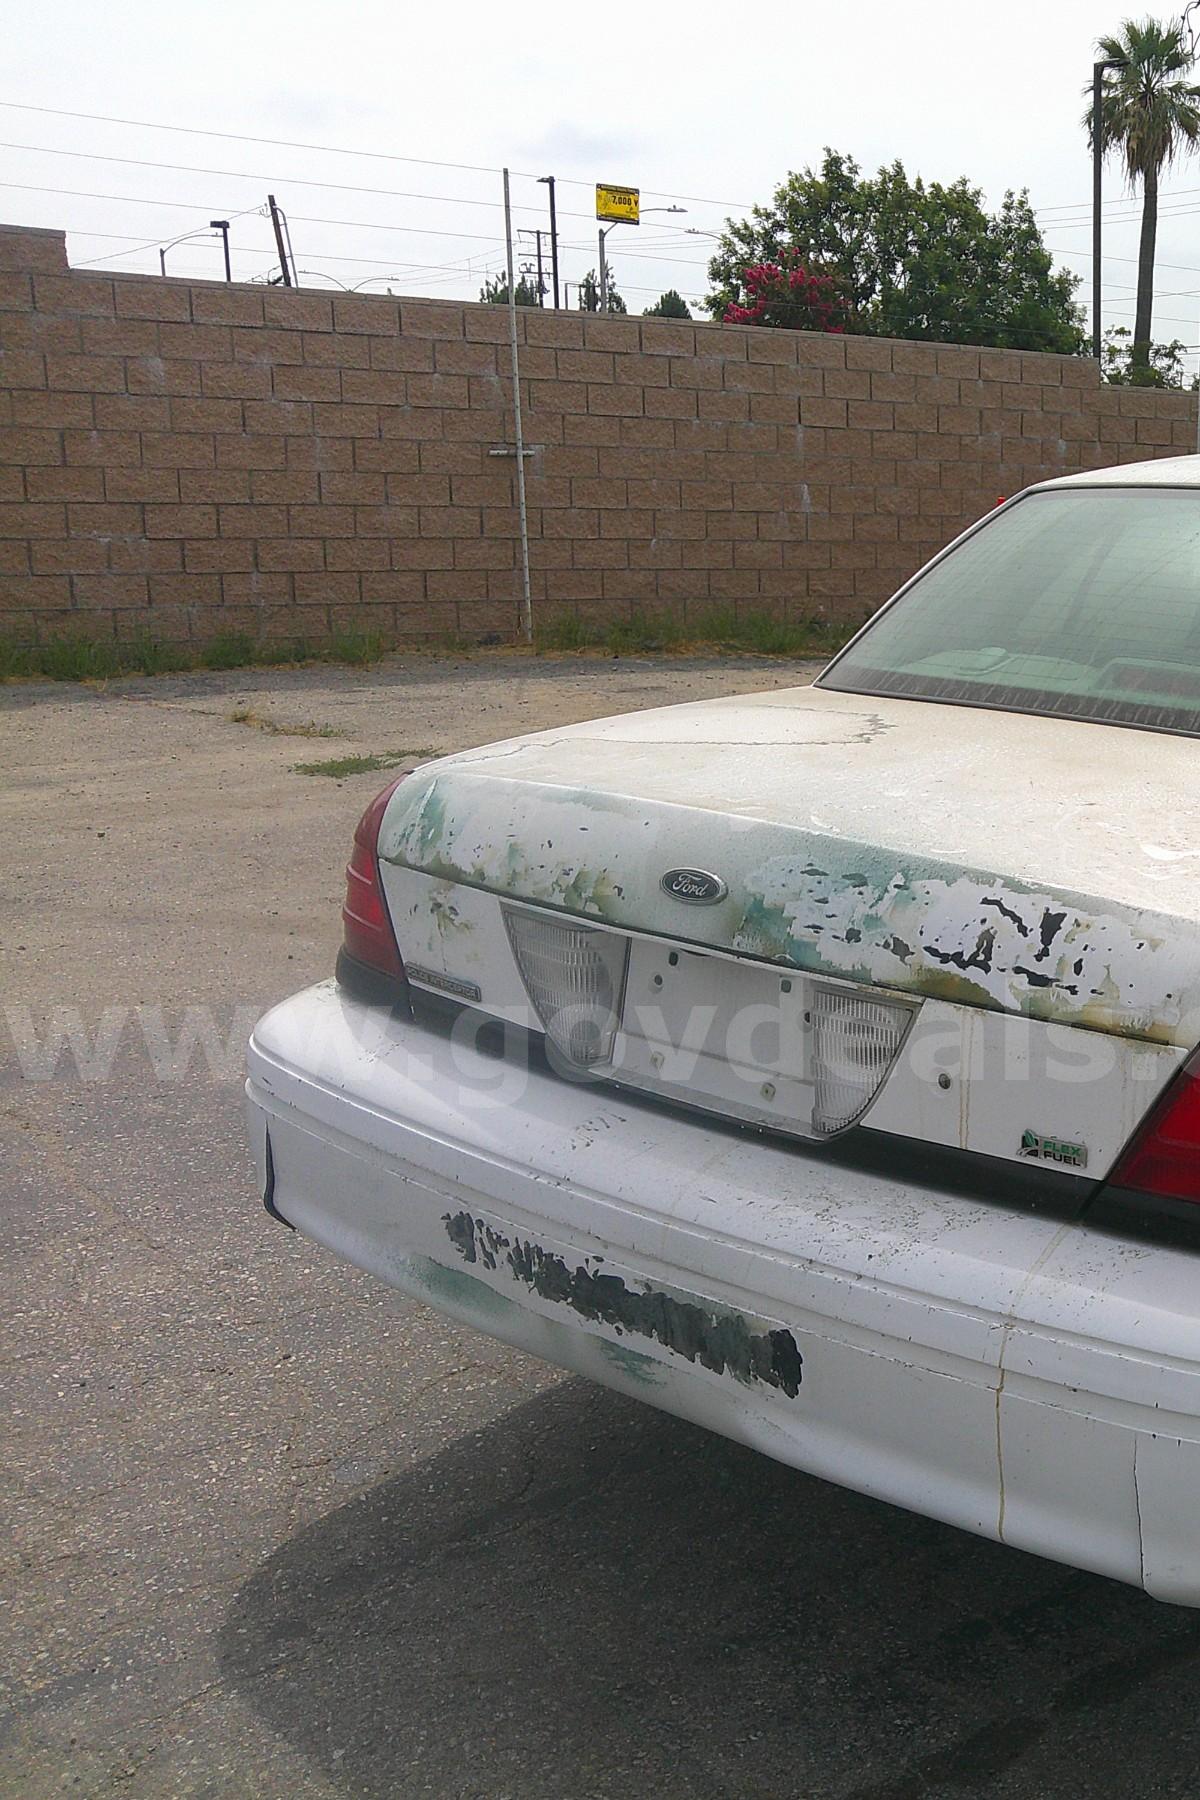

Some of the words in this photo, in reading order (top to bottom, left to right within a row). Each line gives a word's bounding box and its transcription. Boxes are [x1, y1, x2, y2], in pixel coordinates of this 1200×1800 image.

[612, 196, 632, 206] 7,000
[672, 873, 709, 897] Ford
[1043, 1140, 1081, 1157] FLEX
[1043, 1151, 1081, 1167] FUEL
